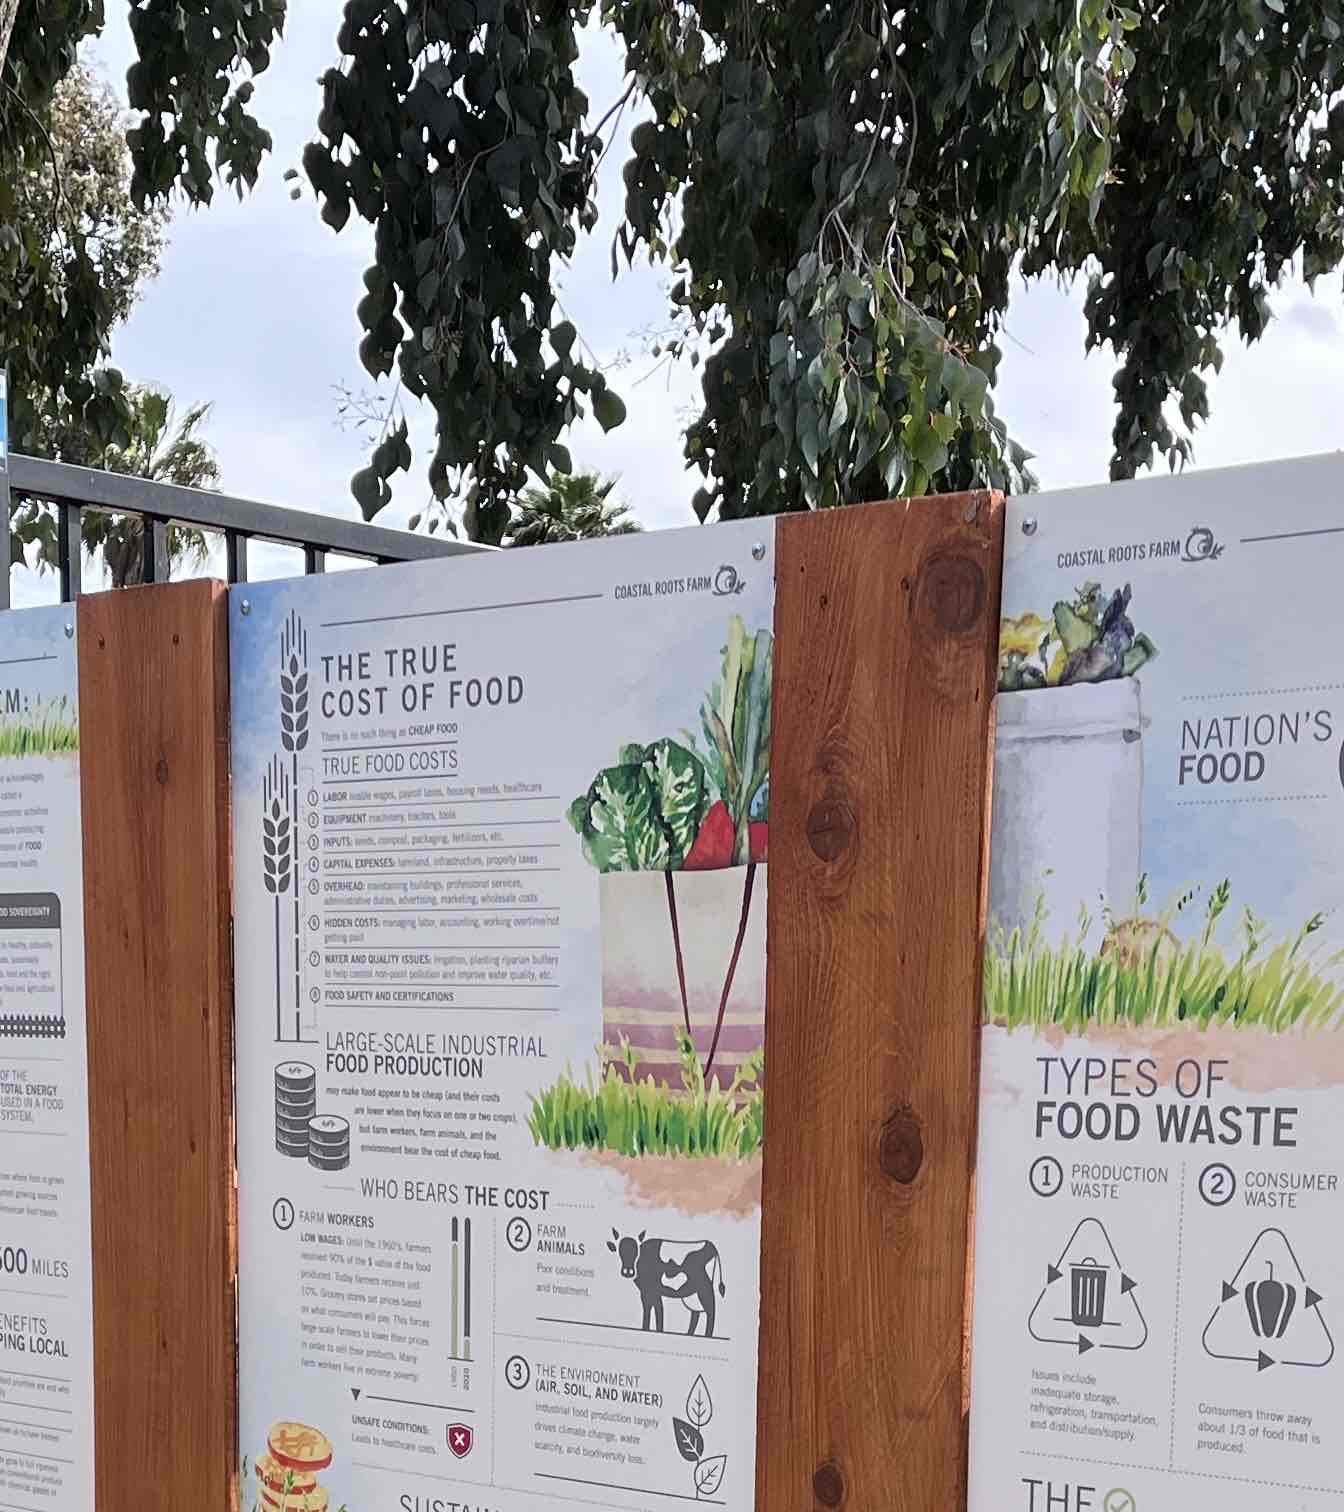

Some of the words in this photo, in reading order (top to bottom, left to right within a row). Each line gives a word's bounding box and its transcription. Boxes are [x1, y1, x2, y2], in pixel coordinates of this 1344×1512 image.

[1056, 547, 1107, 570] COASTAL
[1107, 542, 1147, 565] ROOTS
[1148, 538, 1182, 560] FARM
[613, 582, 654, 601] COASTAL
[653, 577, 686, 597] ROOTS
[685, 575, 713, 593] FARM
[319, 651, 372, 685] THE
[383, 643, 458, 679] TRUE
[320, 685, 389, 720] COST
[400, 681, 436, 714] OF
[448, 674, 524, 710] FOOD
[1180, 709, 1334, 752] NATION'S
[320, 754, 362, 778] TRUE
[364, 750, 406, 774] FOOD
[407, 748, 459, 772] COSTS
[1177, 749, 1266, 787] FOOD
[325, 1030, 438, 1056] LARGE-SCALE
[441, 1033, 549, 1059] INDUSTRIAL
[325, 1052, 370, 1074] FOOD
[373, 1053, 484, 1079] PRODUCTION
[1035, 1055, 1159, 1099] TYPES
[1174, 1058, 1230, 1100] OF
[1034, 1099, 1142, 1142] FOOD
[1154, 1102, 1299, 1148] WASTE
[1070, 1162, 1170, 1184] PRODUCTION
[1243, 1170, 1339, 1192] CONSUMER
[359, 1176, 400, 1201] WHO
[403, 1179, 460, 1205] BEARS
[463, 1184, 500, 1208] THE
[503, 1187, 551, 1212] COST
[1069, 1179, 1120, 1202] WASTE
[1243, 1188, 1298, 1210] WASTE
[297, 1209, 326, 1226] FARM
[325, 1211, 376, 1230] WORKERS
[535, 1222, 568, 1240] FARM
[535, 1238, 586, 1257] ANIMALS
[30, 1257, 70, 1280] MILES
[28, 1334, 70, 1359] LOCAL
[534, 1362, 558, 1381] THE
[559, 1365, 642, 1391] ENVIRONMENT
[534, 1377, 562, 1396] (AIR,
[562, 1380, 593, 1401] SOIL,
[593, 1385, 620, 1402] AND
[620, 1388, 664, 1410] WATER)
